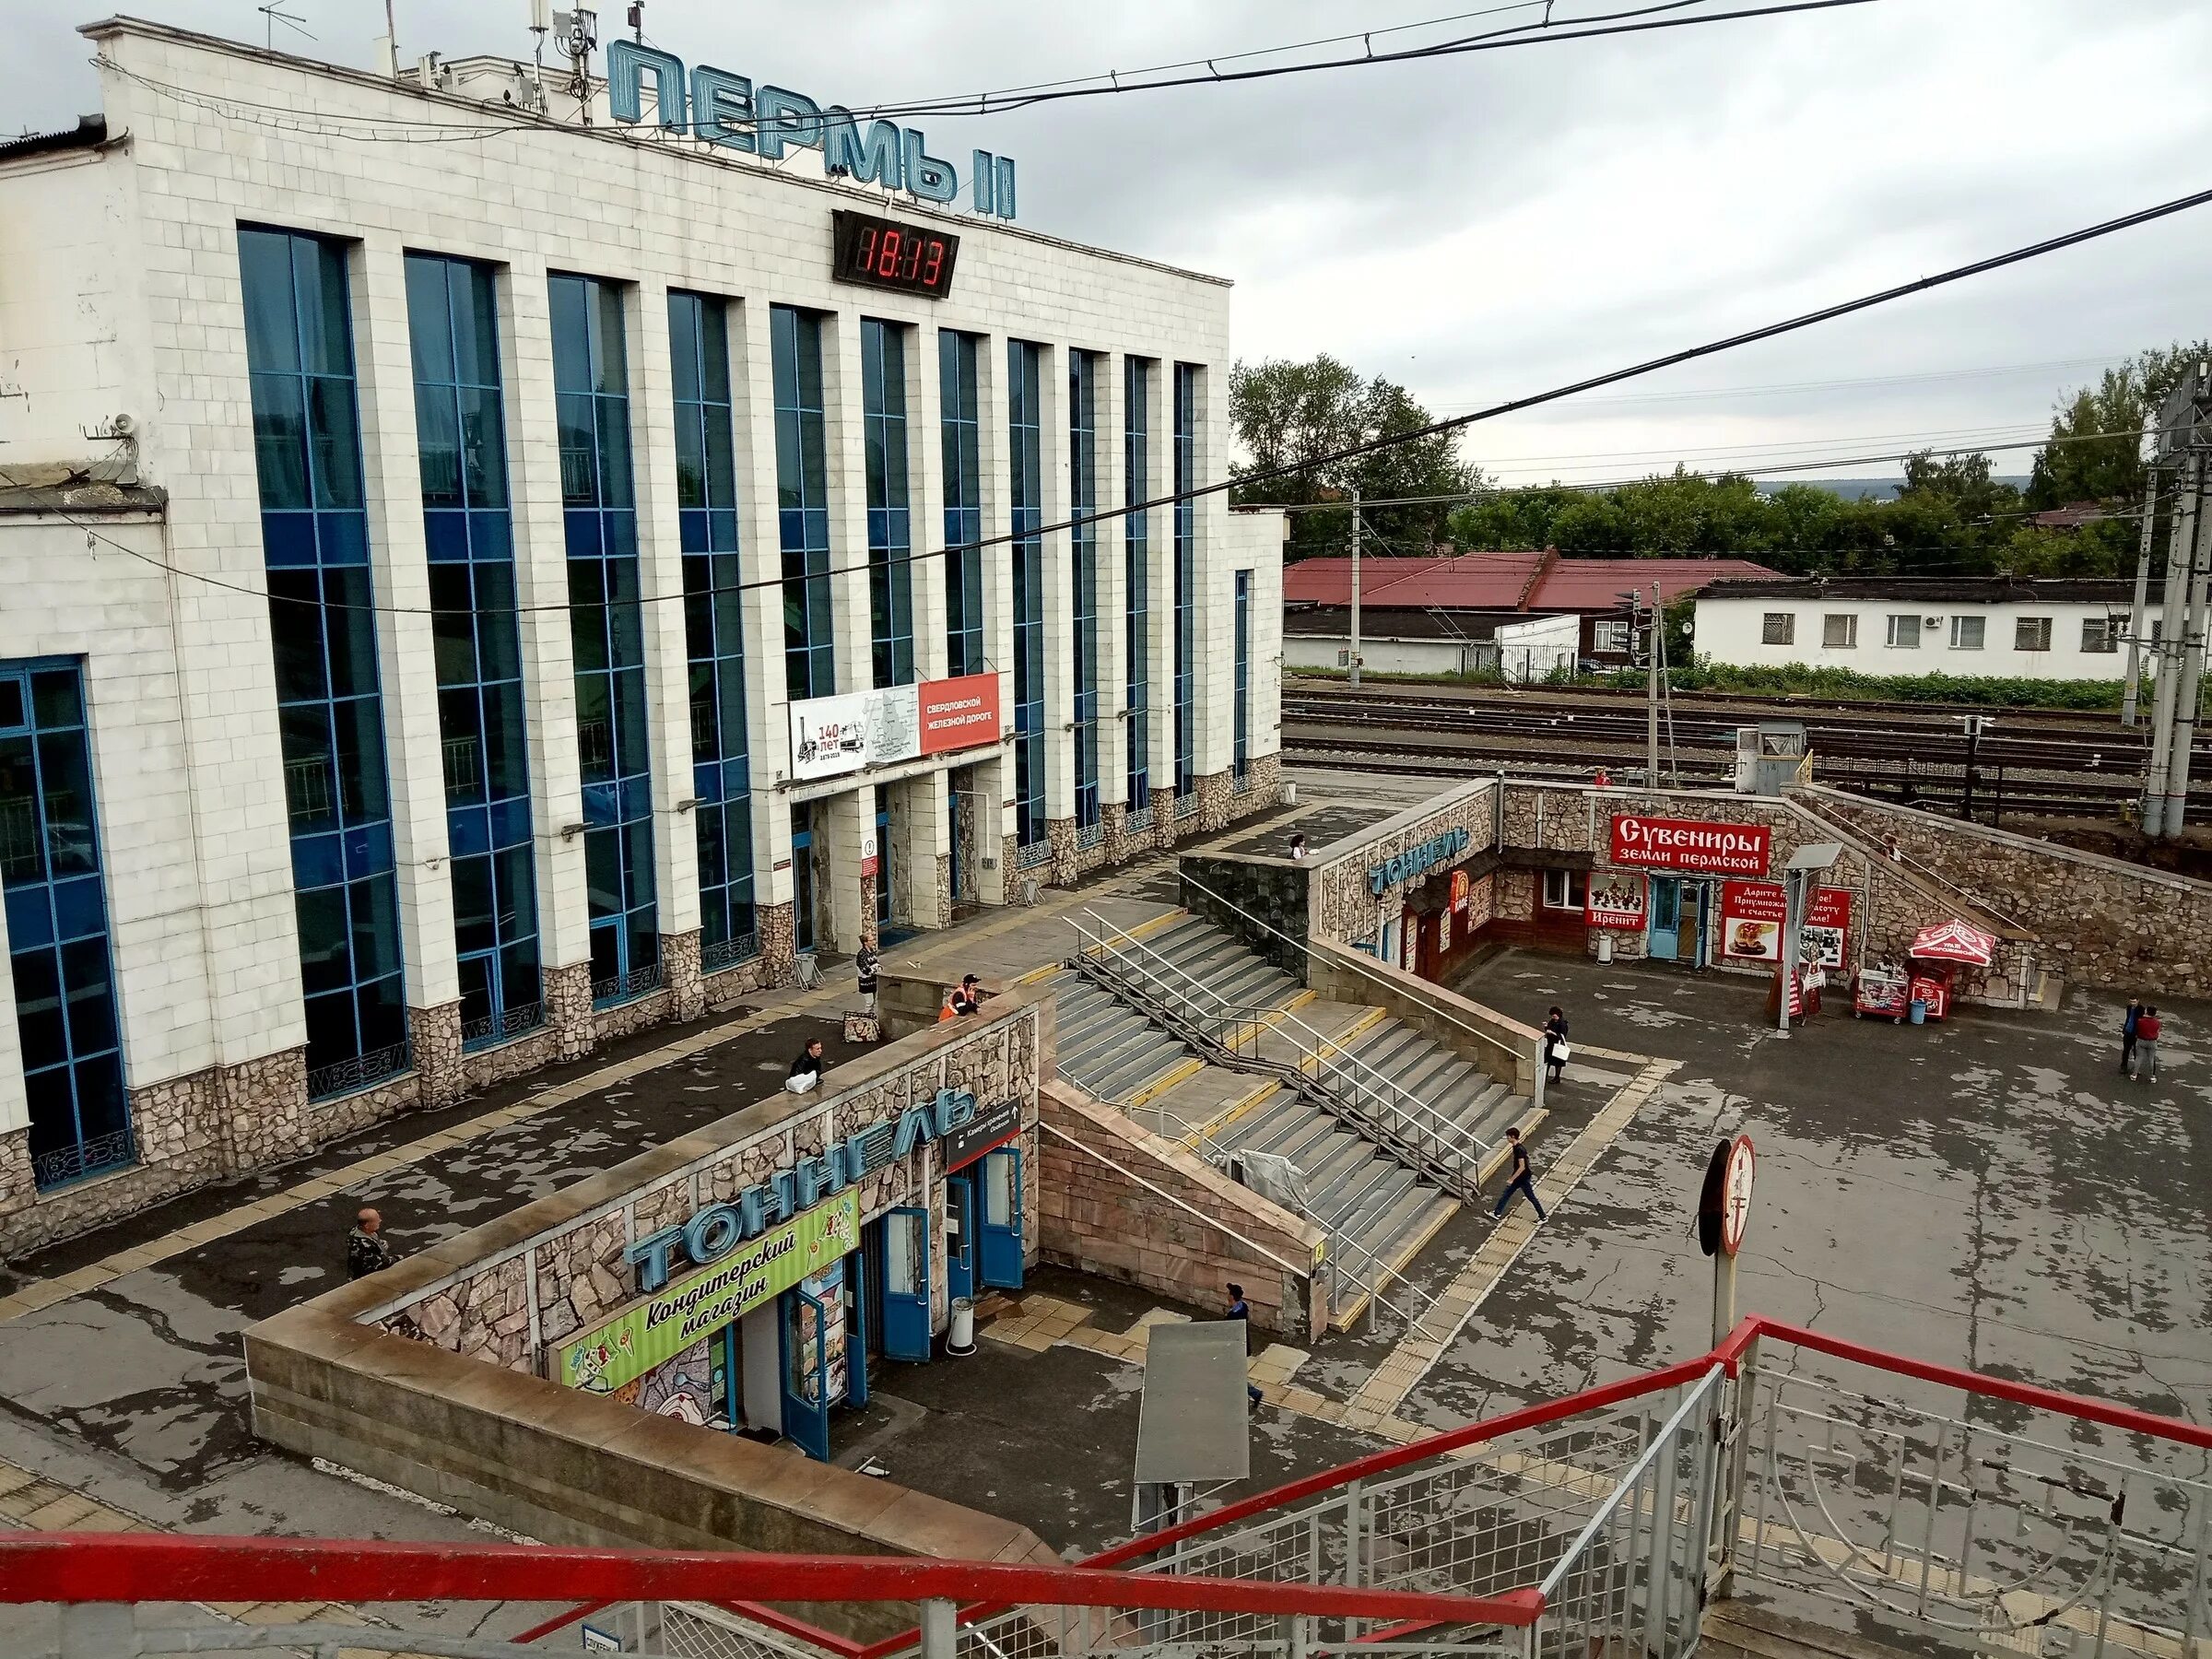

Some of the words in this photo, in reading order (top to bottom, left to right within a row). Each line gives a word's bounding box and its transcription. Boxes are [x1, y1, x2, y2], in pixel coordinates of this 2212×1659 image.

[606, 39, 959, 204] ПЕРМЬ
[972, 148, 1017, 220] II
[864, 229, 945, 286] 18:13
[926, 695, 982, 714] СВЕРДЛОВСКОЙ
[818, 724, 840, 740] 140
[927, 713, 966, 731] ЖЕЛЕЗНОЙ
[966, 710, 993, 725] ДОРОГЕ
[820, 739, 840, 752] лет
[1618, 818, 1762, 856] Сувениры
[1369, 826, 1471, 895] ТОННЕЛЬ
[1618, 847, 1672, 863] земли
[1679, 853, 1759, 870] пермской
[1734, 896, 1787, 908] Приумножа
[1744, 887, 1777, 898] Дарите
[1592, 911, 1639, 926] Иренит
[1748, 910, 1783, 918] счастье
[967, 1121, 987, 1138] Камеры
[986, 1109, 1009, 1126] хранения
[623, 1087, 978, 1293] ТОННЕЛЬ
[645, 1227, 797, 1332] Кондитерский
[679, 1275, 770, 1341] магазин
